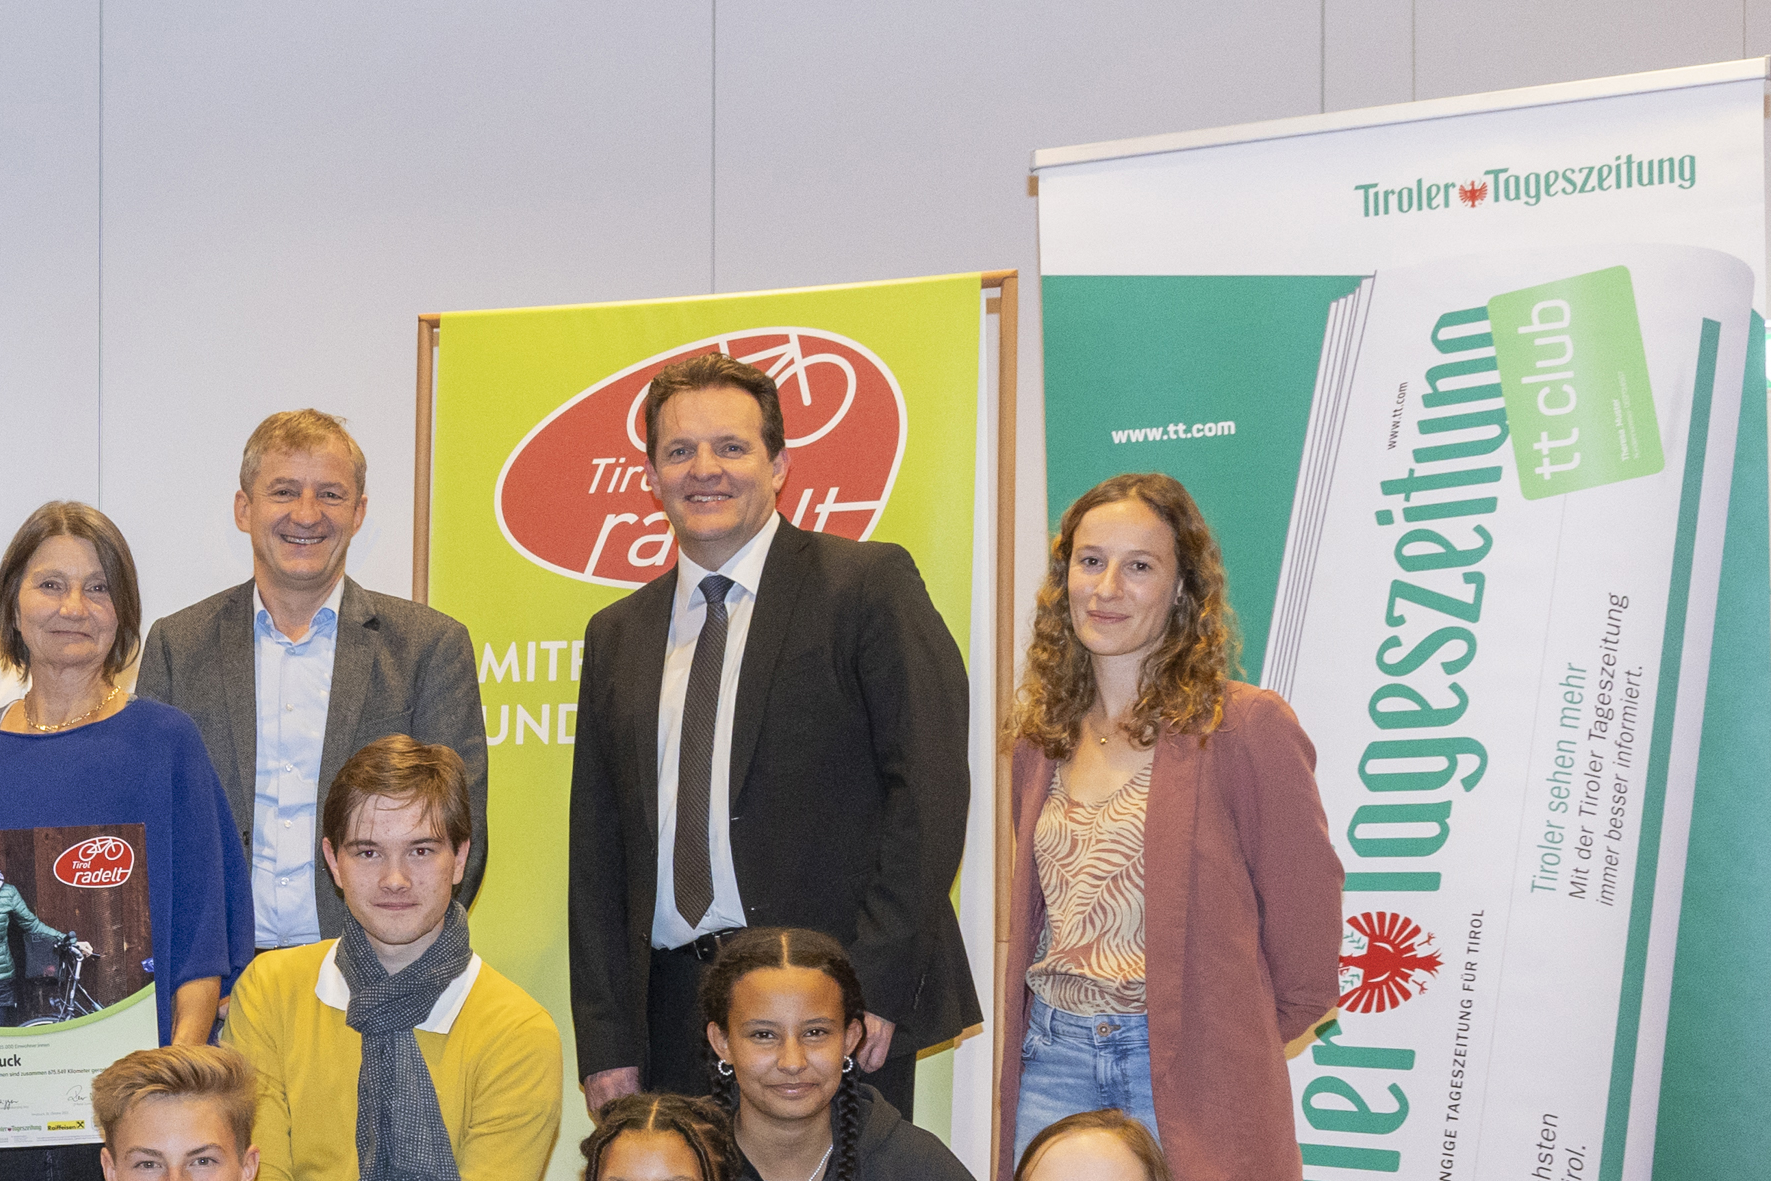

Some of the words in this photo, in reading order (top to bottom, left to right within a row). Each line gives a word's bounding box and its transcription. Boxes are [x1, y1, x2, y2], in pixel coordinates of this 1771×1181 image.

[1354, 178, 1456, 217] Tiroler
[1483, 154, 1696, 206] Tageszeitung
[1517, 298, 1577, 416] club
[1111, 421, 1235, 444] www.tt.com
[1386, 381, 1408, 451] www.tt.com
[1534, 427, 1581, 479] tt
[1559, 663, 1587, 729] mehr
[1588, 593, 1629, 742] Tageszeitung
[1613, 666, 1643, 768] informiert.
[1546, 740, 1577, 814] sehen
[1578, 751, 1604, 820] Tiroler
[1604, 774, 1628, 842] besser
[73, 861, 91, 869] Tirol
[1531, 820, 1565, 893] Tiroler
[1574, 826, 1594, 860] der
[74, 867, 124, 885] radelt
[1569, 868, 1589, 899] Mit
[1596, 846, 1619, 907] immer
[1466, 909, 1484, 955] TIROL
[1460, 961, 1477, 992] FÜR
[1446, 999, 1474, 1122] TAGESZEITUNG
